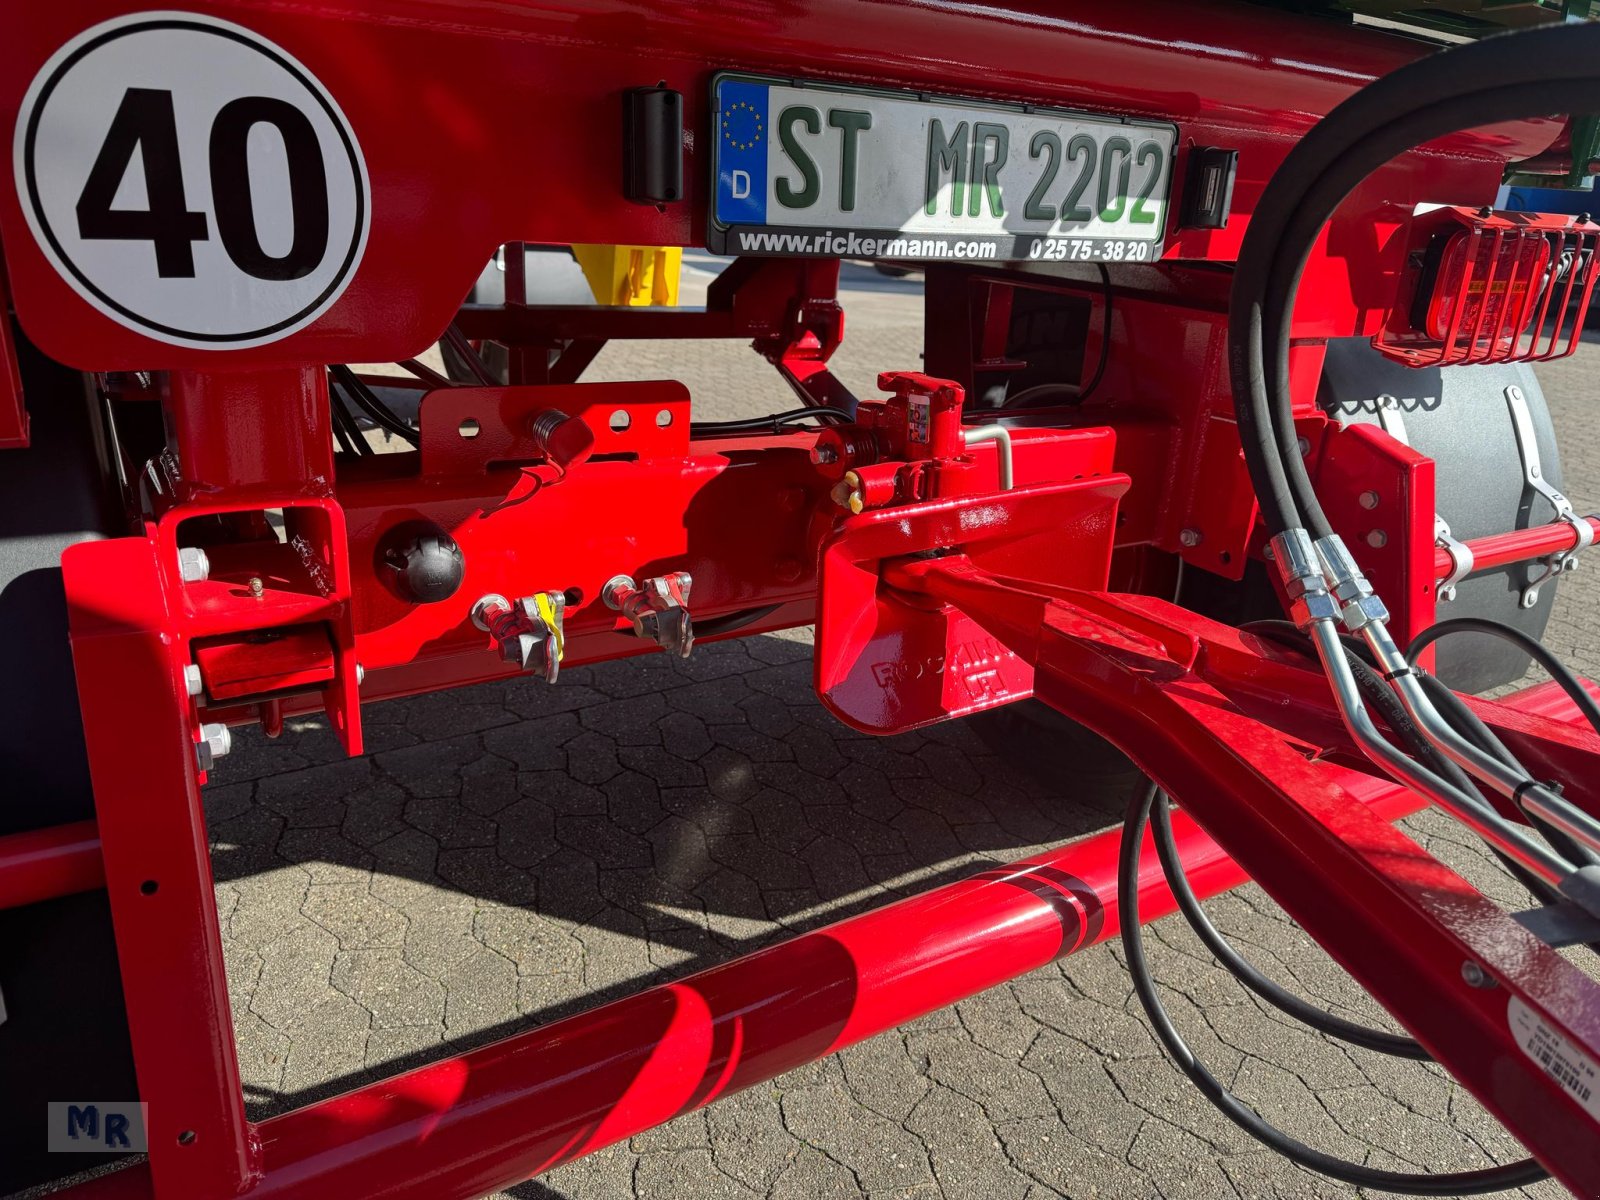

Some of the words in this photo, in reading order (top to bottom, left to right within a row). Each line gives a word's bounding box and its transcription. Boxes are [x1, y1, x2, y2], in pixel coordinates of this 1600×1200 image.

[75, 86, 330, 282] 40
[731, 169, 752, 200] D
[775, 104, 873, 213] ST
[925, 118, 1011, 219] MR
[1023, 129, 1165, 225] 2202
[739, 231, 997, 259] www.rickermann.com
